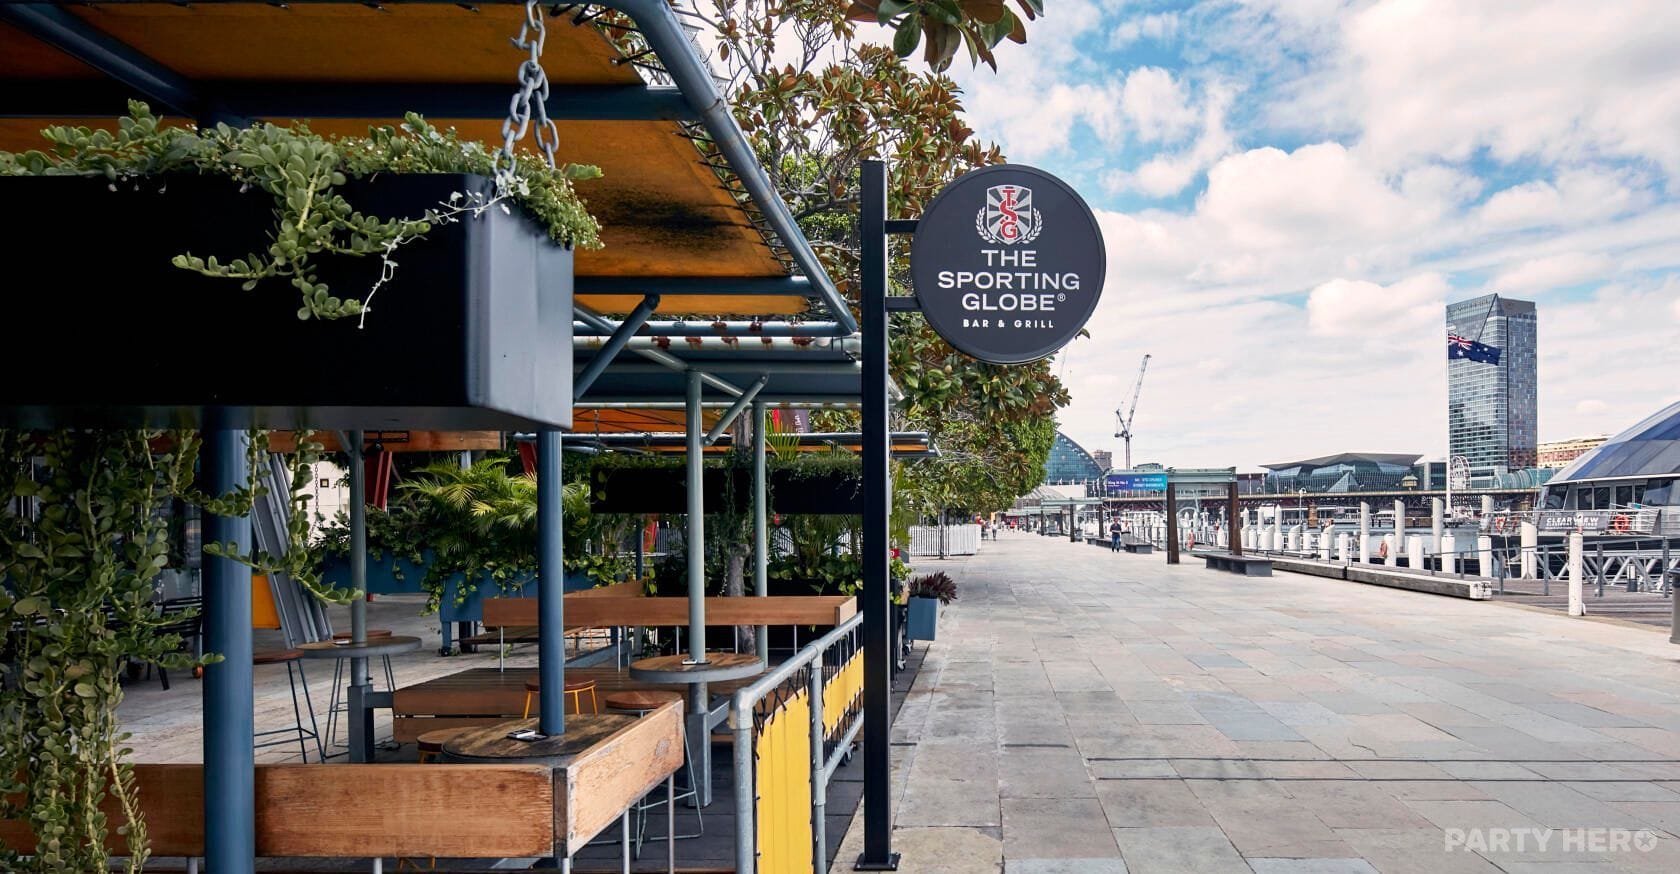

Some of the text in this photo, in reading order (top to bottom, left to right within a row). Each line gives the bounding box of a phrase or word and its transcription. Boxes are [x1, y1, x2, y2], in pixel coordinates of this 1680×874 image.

[981, 249, 1037, 267] THE
[937, 271, 1080, 290] SPORTING
[963, 319, 1054, 329] BAR & GRILL
